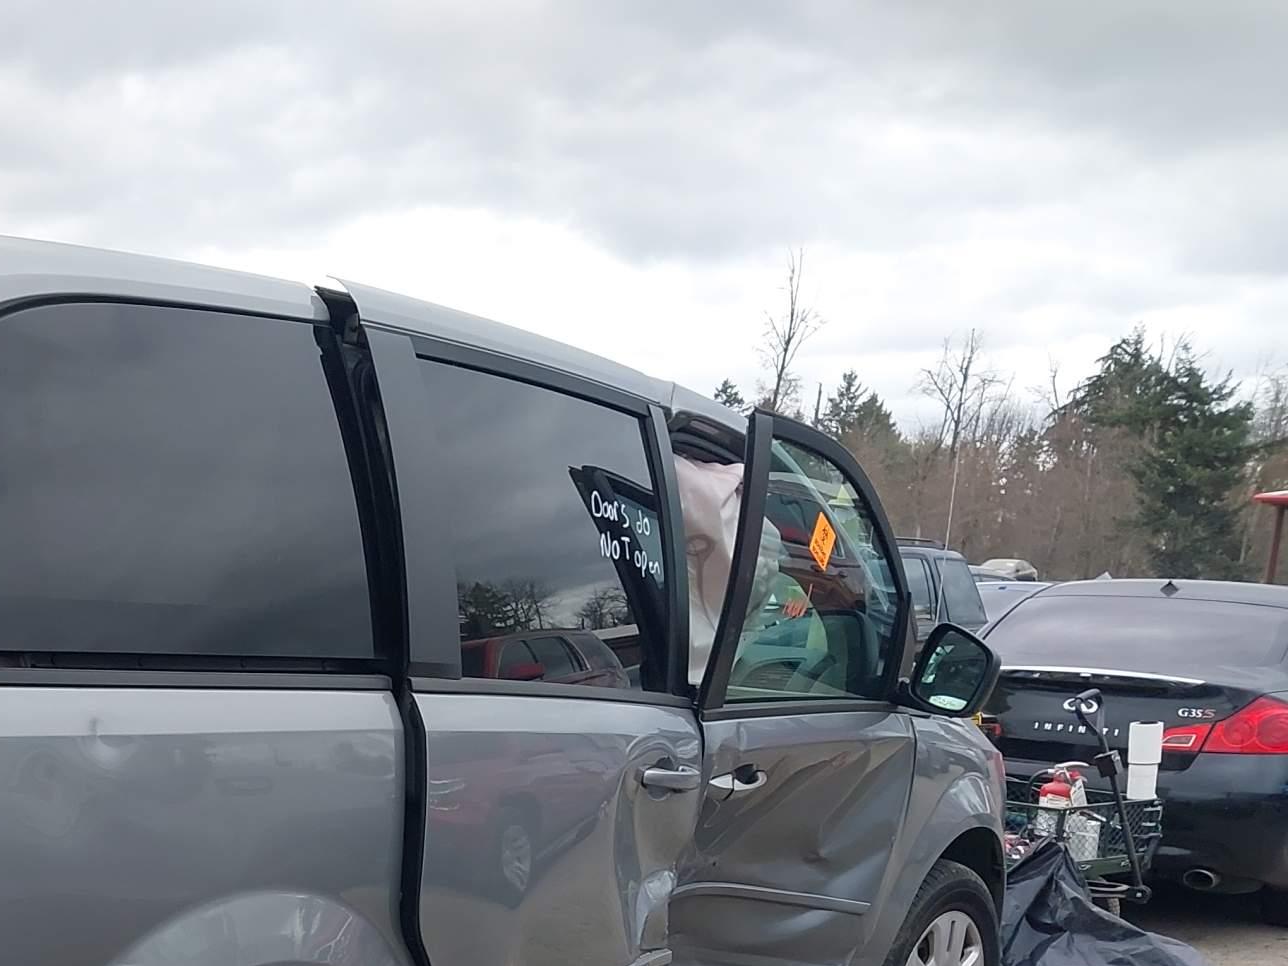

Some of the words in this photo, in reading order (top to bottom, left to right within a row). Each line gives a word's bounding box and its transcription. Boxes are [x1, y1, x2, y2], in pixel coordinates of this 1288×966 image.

[591, 490, 631, 529] Doors
[634, 550, 661, 578] open
[1034, 721, 1120, 737] INFINTI
